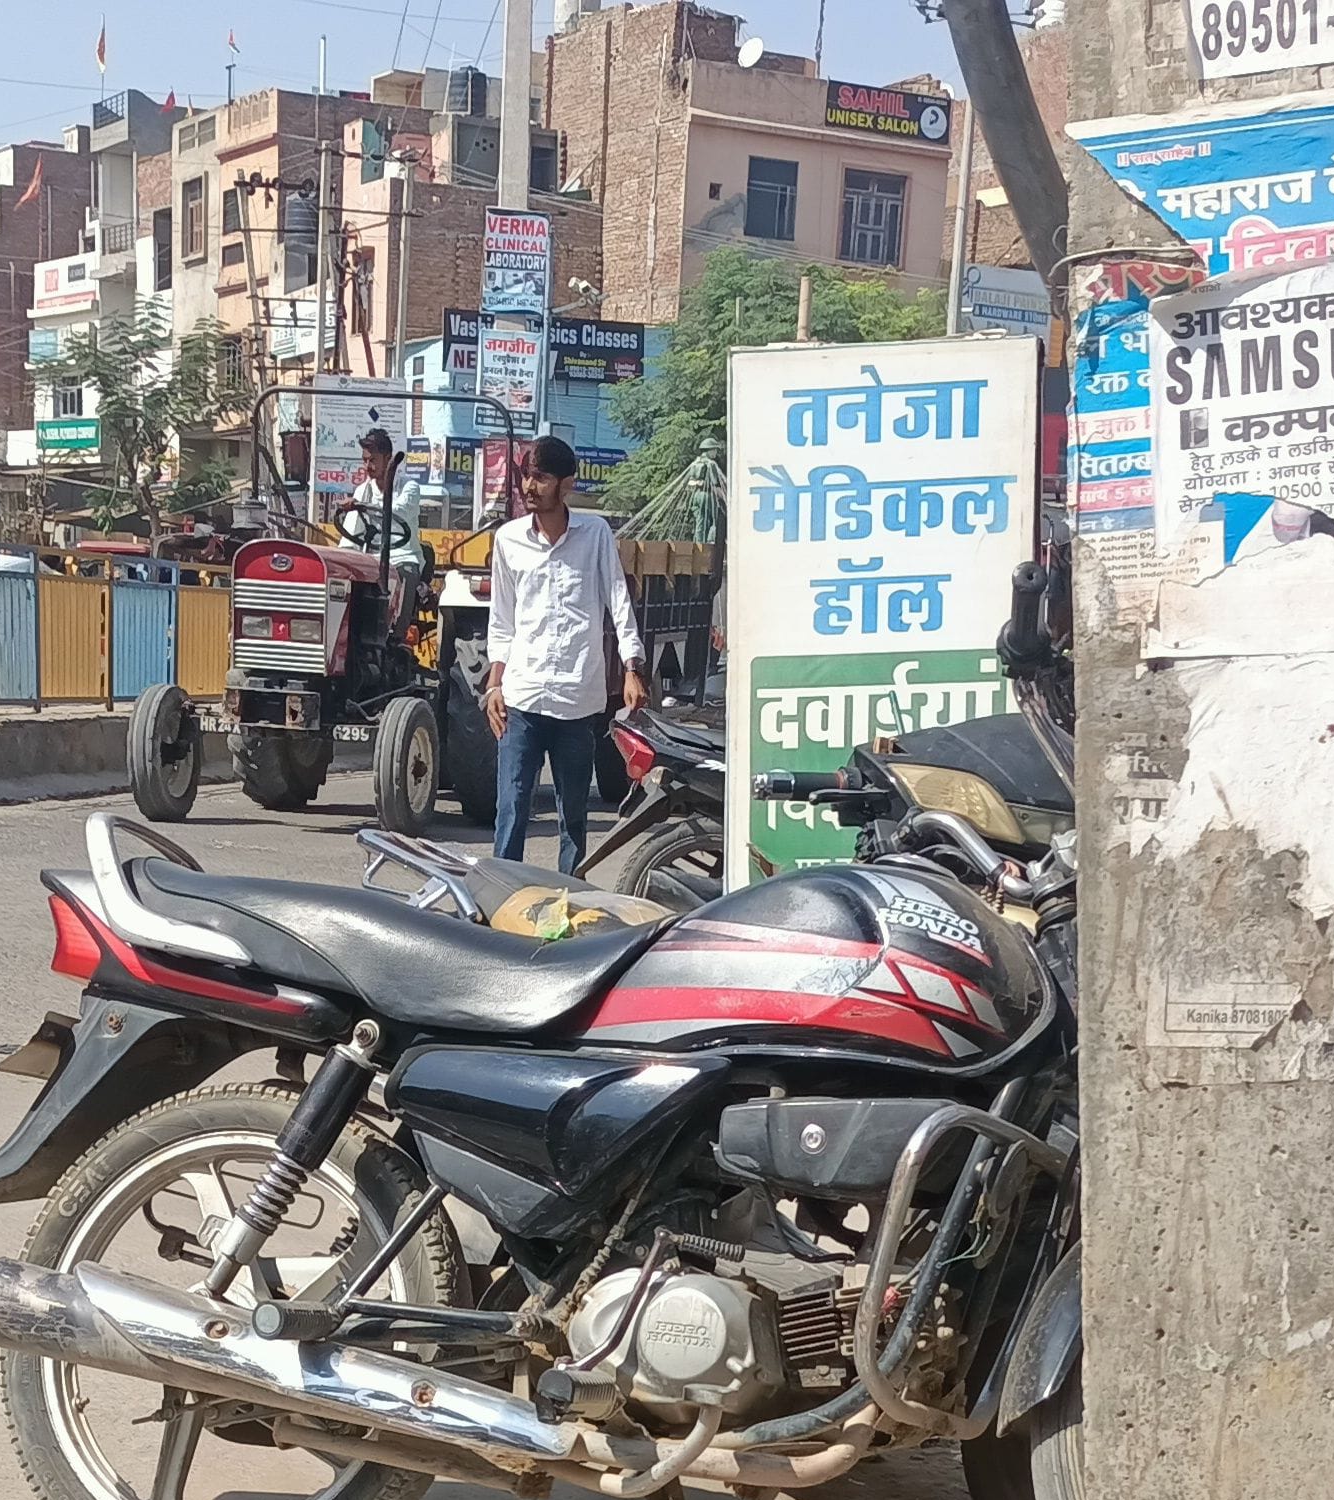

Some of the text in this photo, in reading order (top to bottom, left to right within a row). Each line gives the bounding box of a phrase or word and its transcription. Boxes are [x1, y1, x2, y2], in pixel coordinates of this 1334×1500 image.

[838, 85, 910, 119] SAHIL
[826, 107, 919, 136] UNISEX SALON
[1156, 168, 1316, 220] महाराज
[486, 215, 547, 238] VERMA
[485, 237, 547, 253] CLINICAL
[484, 252, 547, 271] LABORATORY
[581, 324, 638, 350] Classes
[782, 365, 989, 447] तनेजा
[1077, 450, 1153, 480] सितम्ब
[1267, 445, 1281, 460] व
[1182, 470, 1250, 491] योग्यता
[748, 464, 1018, 544] मैडिकल
[1113, 486, 1127, 502] 5
[1106, 562, 1138, 572] shram
[809, 556, 952, 636] हॉल
[756, 658, 1002, 750] दवाईयां
[890, 895, 980, 936] HERO
[875, 907, 985, 955] HONDA
[1185, 1008, 1229, 1025] Kanika
[646, 1330, 716, 1350] HONDA
[655, 1320, 707, 1337] HERO
